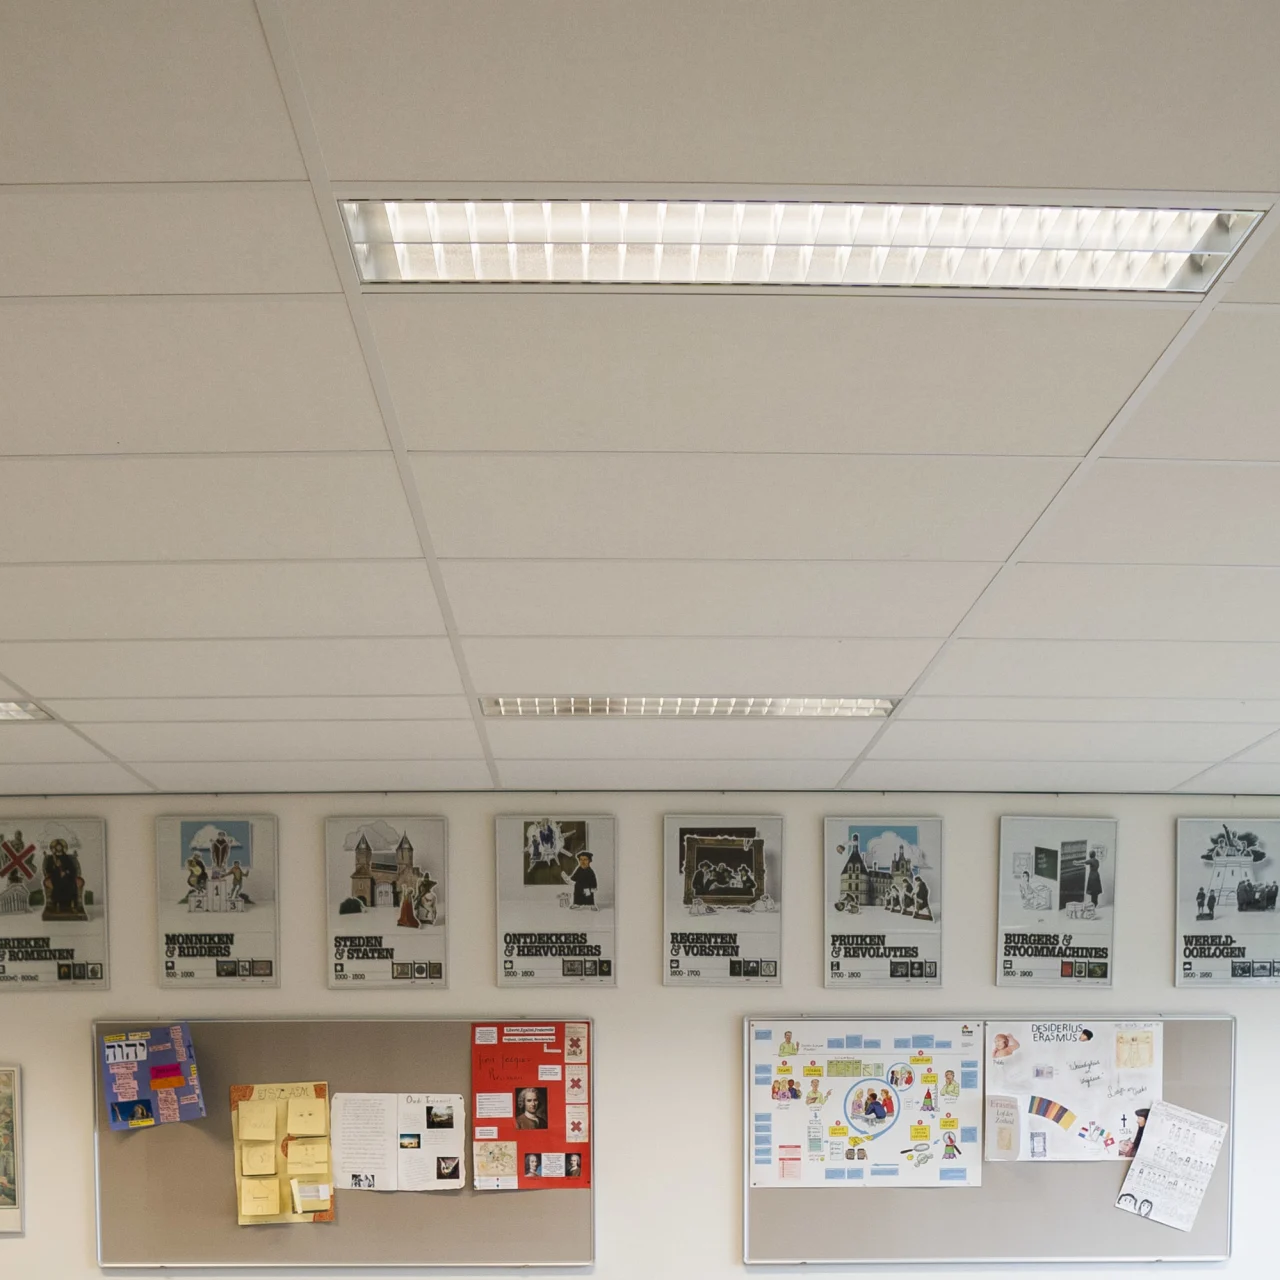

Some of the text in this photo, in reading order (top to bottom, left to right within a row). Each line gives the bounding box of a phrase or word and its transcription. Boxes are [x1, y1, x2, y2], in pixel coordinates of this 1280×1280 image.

[196, 900, 202, 908] 2
[230, 902, 236, 910] 3
[165, 933, 234, 945] MONNIKEN
[334, 936, 383, 948] STEDEN
[504, 933, 587, 945] ONTDEKKERS
[670, 933, 737, 944] REGENTEN
[831, 934, 886, 946] PRUIKEN
[1004, 933, 1073, 946] BURGERS &
[1183, 935, 1237, 947] WERELD-
[8, 949, 75, 961] ROMEINEN
[166, 946, 231, 958] & RIDDERS
[335, 948, 394, 960] & STATEN
[504, 945, 601, 957] & HERVORMERS
[671, 944, 740, 957] & VORSTEN
[831, 946, 919, 958] & REVOLUTIES
[1003, 945, 1109, 959] STOOMMACHINES
[1183, 946, 1247, 958] OORLOGEN
[1031, 1023, 1083, 1034] DESIDERIUS
[1033, 1032, 1078, 1043] ERASMUS
[106, 1042, 146, 1061] יהוה
[258, 1086, 309, 1101] ISLAM
